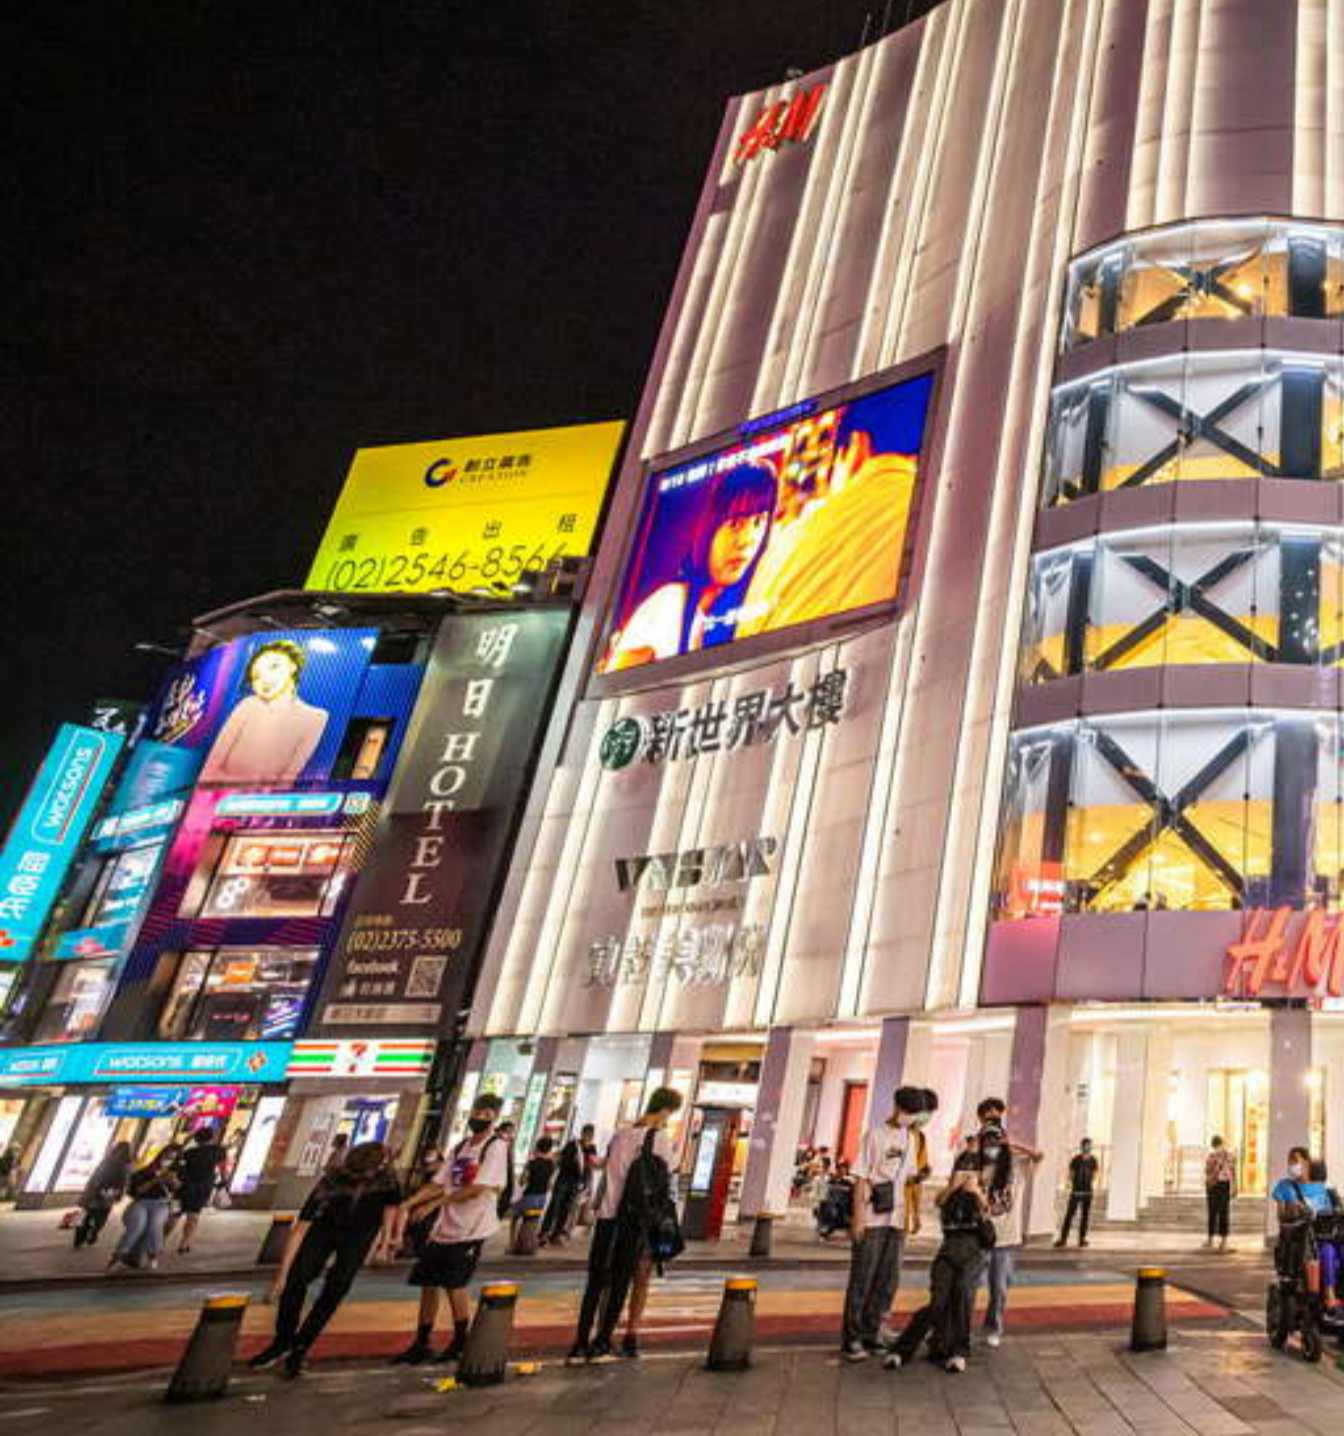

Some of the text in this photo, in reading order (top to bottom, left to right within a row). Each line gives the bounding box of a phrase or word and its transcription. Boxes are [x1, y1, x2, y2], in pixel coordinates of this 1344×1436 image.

[734, 83, 826, 160] H&M
[461, 623, 519, 719] 明日
[640, 668, 848, 764] 新世界大樓
[400, 732, 480, 905] HOTEL
